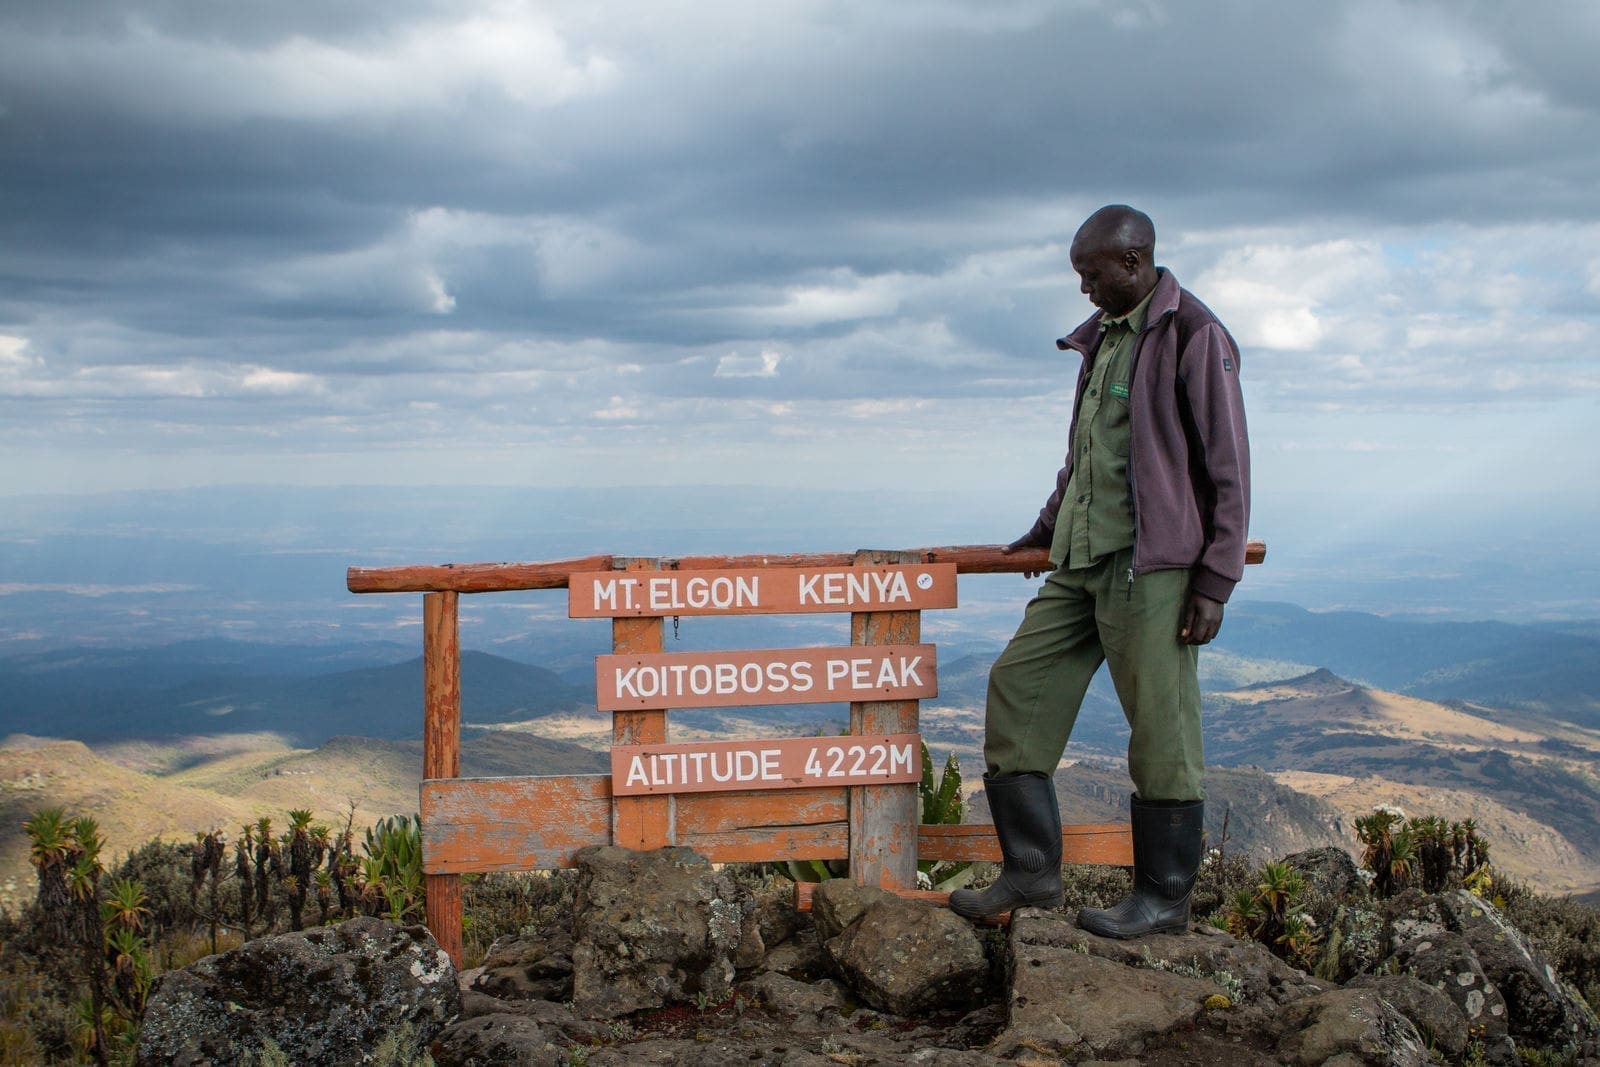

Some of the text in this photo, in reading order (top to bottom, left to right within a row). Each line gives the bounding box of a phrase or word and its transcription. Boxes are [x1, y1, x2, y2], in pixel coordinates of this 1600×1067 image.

[593, 571, 912, 611] MT. ELGON KENYA
[615, 656, 924, 698] KOITOBOSS PEAK
[626, 744, 914, 787] ALTITUDE 4222M
